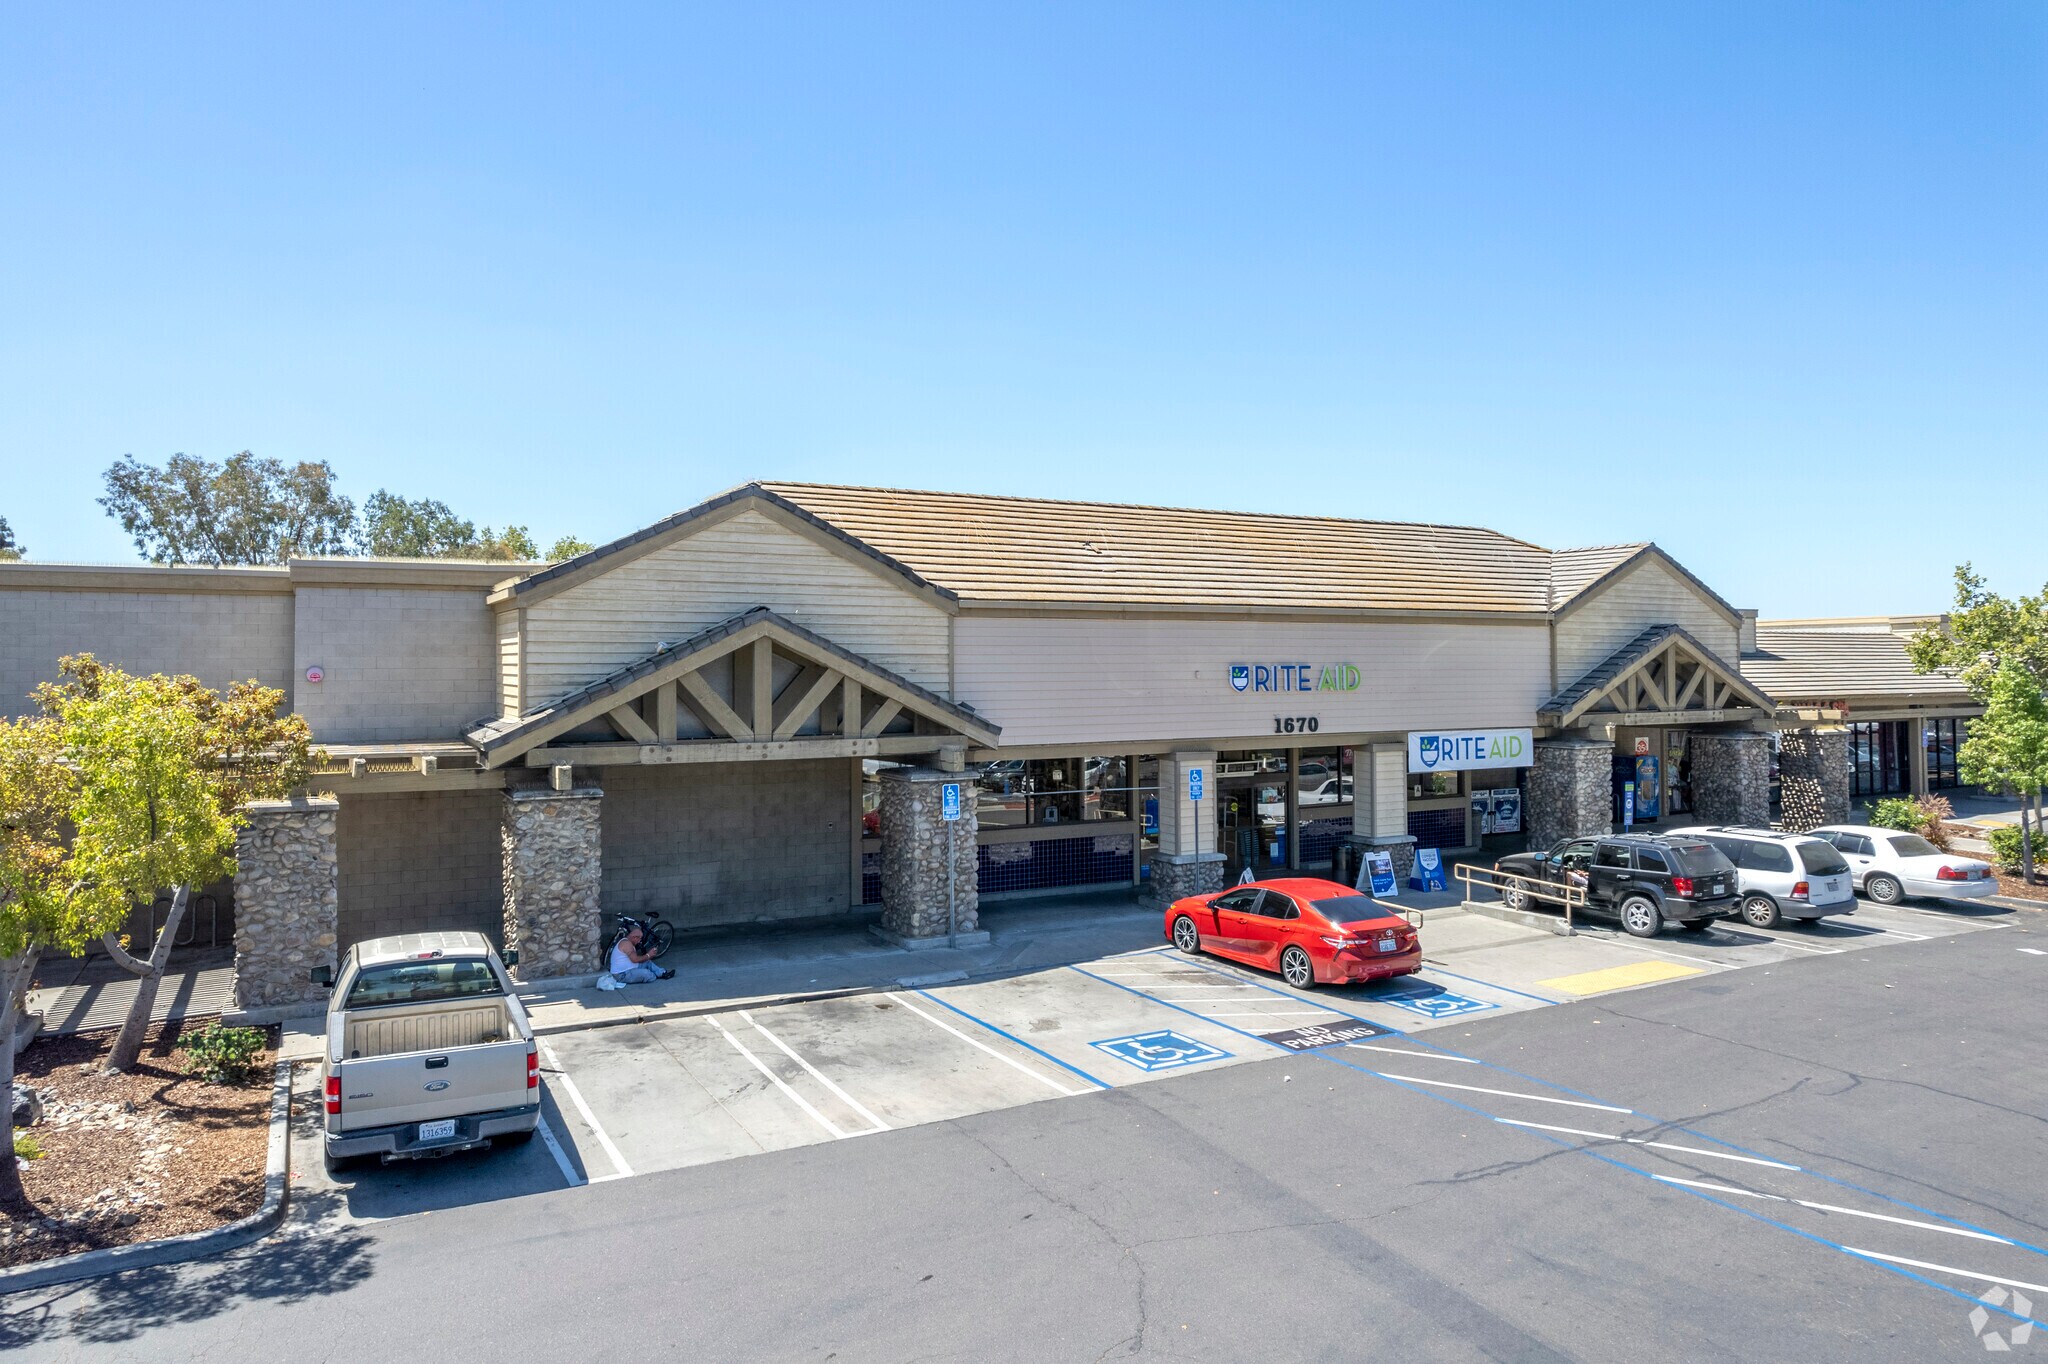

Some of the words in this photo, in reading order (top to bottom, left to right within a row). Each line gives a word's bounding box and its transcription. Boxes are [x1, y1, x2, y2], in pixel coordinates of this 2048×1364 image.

[1253, 665, 1312, 692] RITE
[1317, 664, 1361, 691] AID
[1274, 716, 1319, 733] 1670
[1442, 737, 1486, 761] RITE
[1489, 735, 1522, 759] AID
[1281, 1027, 1375, 1048] PARKING
[1293, 1026, 1330, 1037] NO
